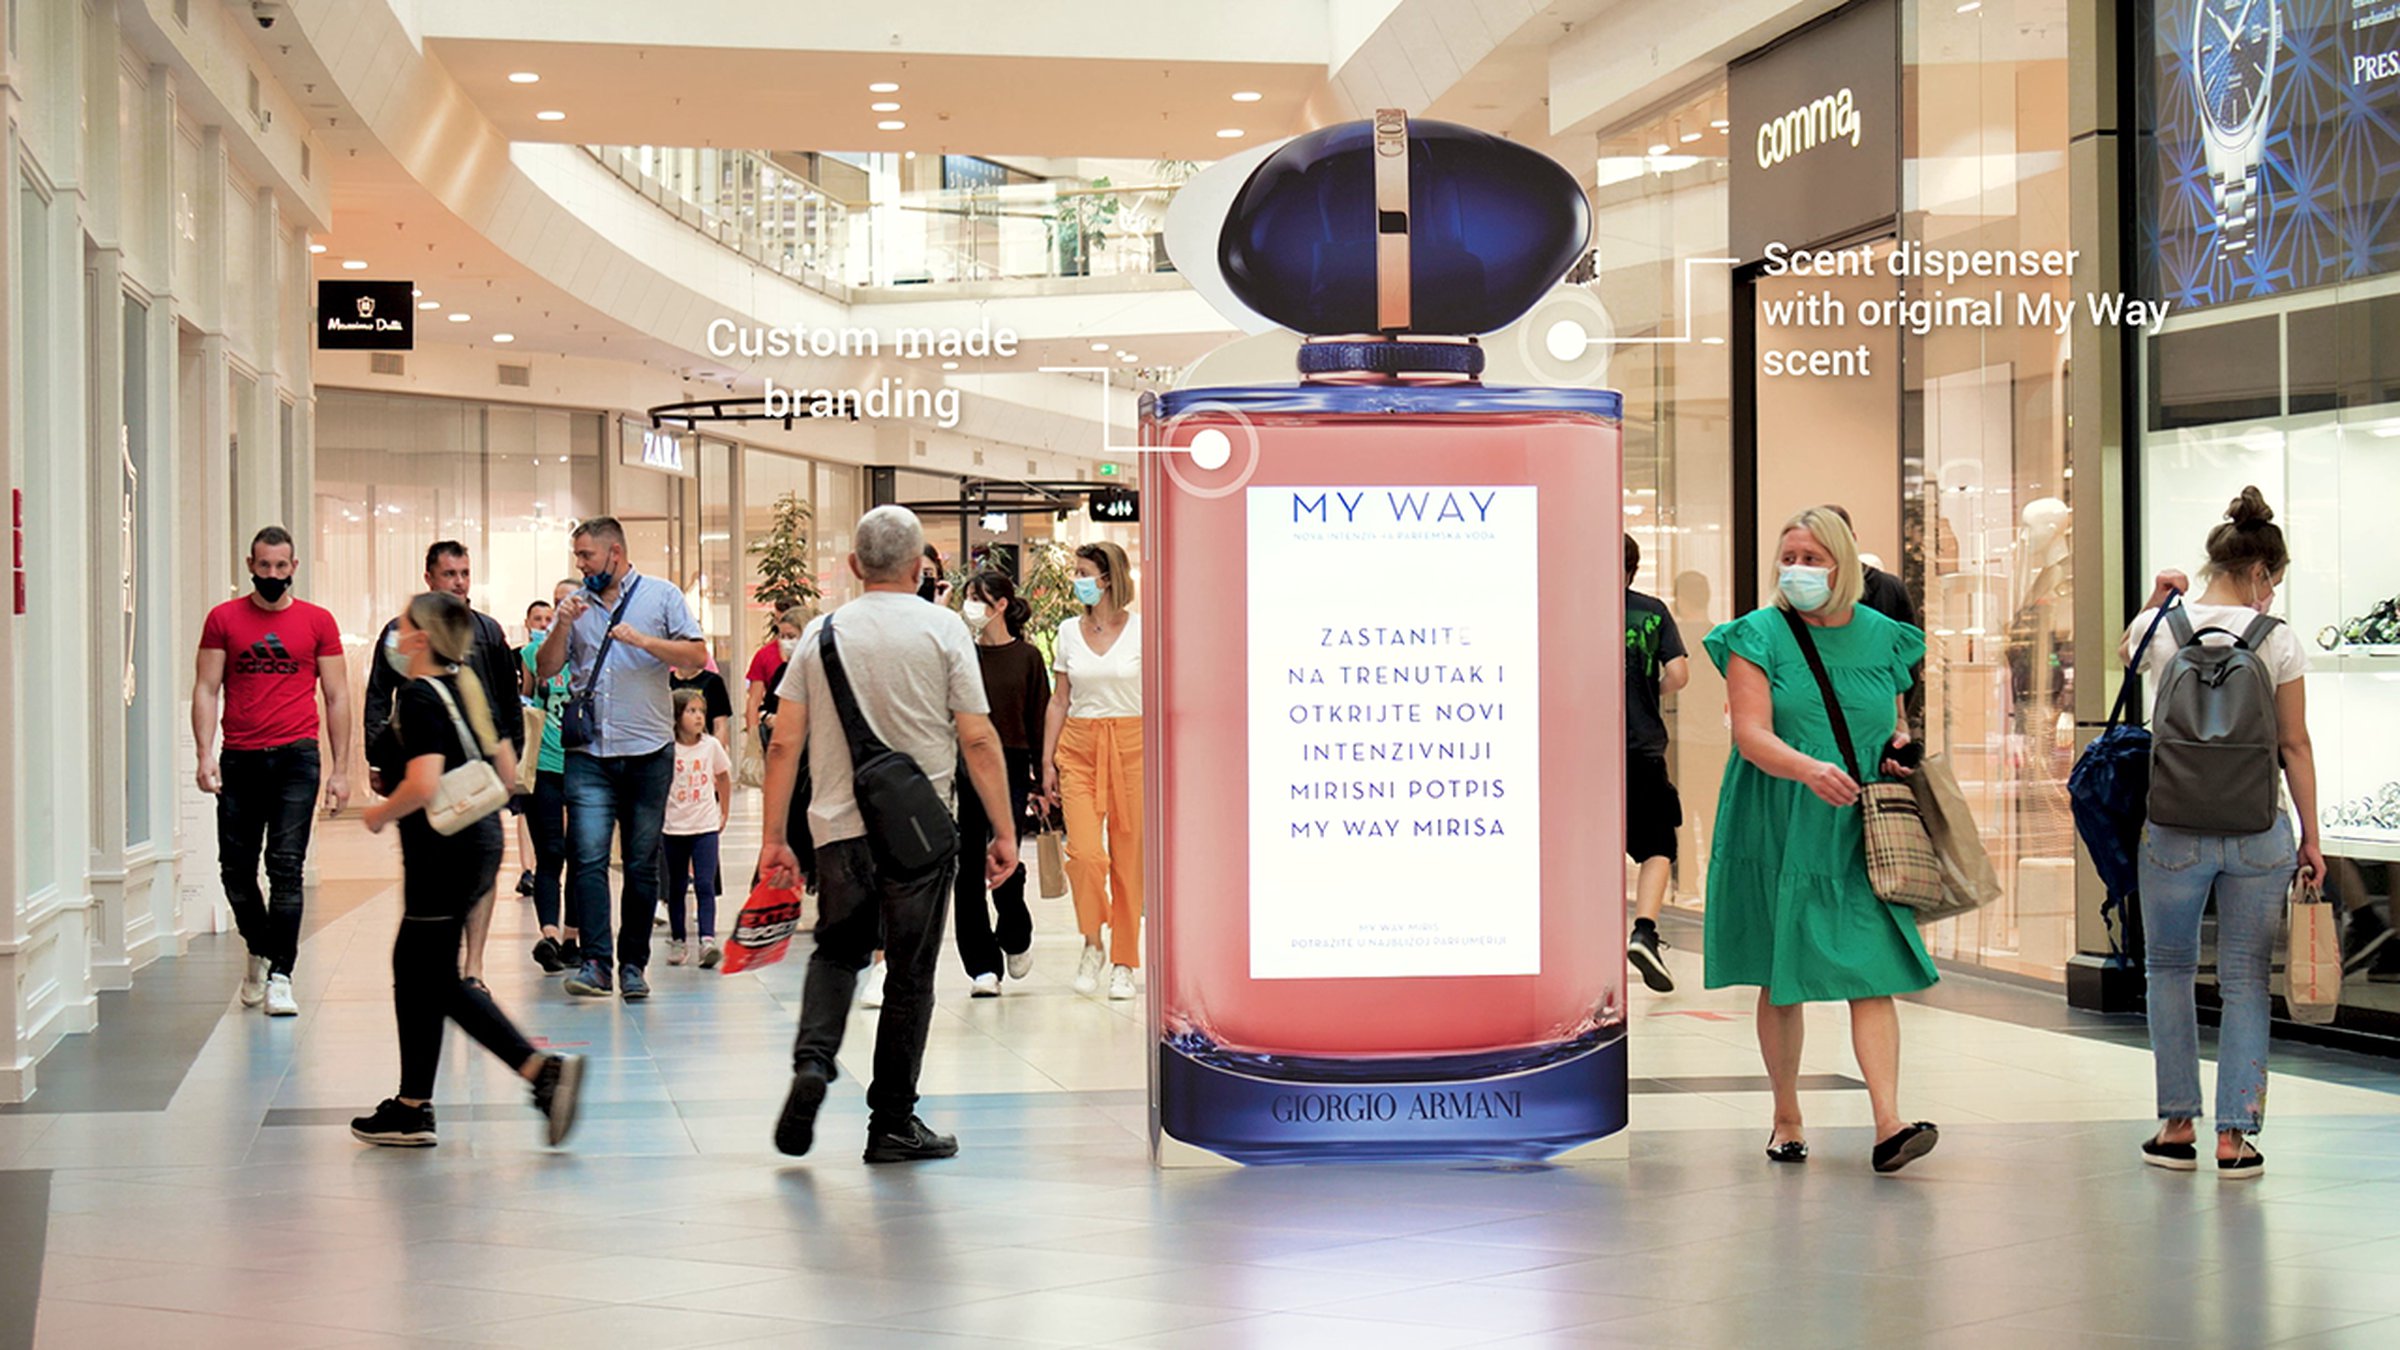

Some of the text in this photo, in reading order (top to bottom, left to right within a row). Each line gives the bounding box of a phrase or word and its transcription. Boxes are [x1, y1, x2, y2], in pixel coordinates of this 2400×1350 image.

[2353, 50, 2400, 85] PRES
[1757, 87, 1861, 169] comma,
[643, 430, 684, 472] ZARA
[1293, 490, 1496, 523] MY WAY
[1320, 627, 1472, 649] ZASTANITE
[235, 660, 299, 675] adidas
[1288, 664, 1504, 686] NA TRENUTAK I
[1288, 702, 1504, 725] OTKRIJTE NOVI
[1303, 741, 1491, 762] INTENZIVNIJI
[1290, 778, 1506, 801] MIRISNI POTPIS
[1290, 817, 1505, 839] MY WAY MIRISA
[1271, 1090, 1522, 1123] GIORGIO ARMANI
